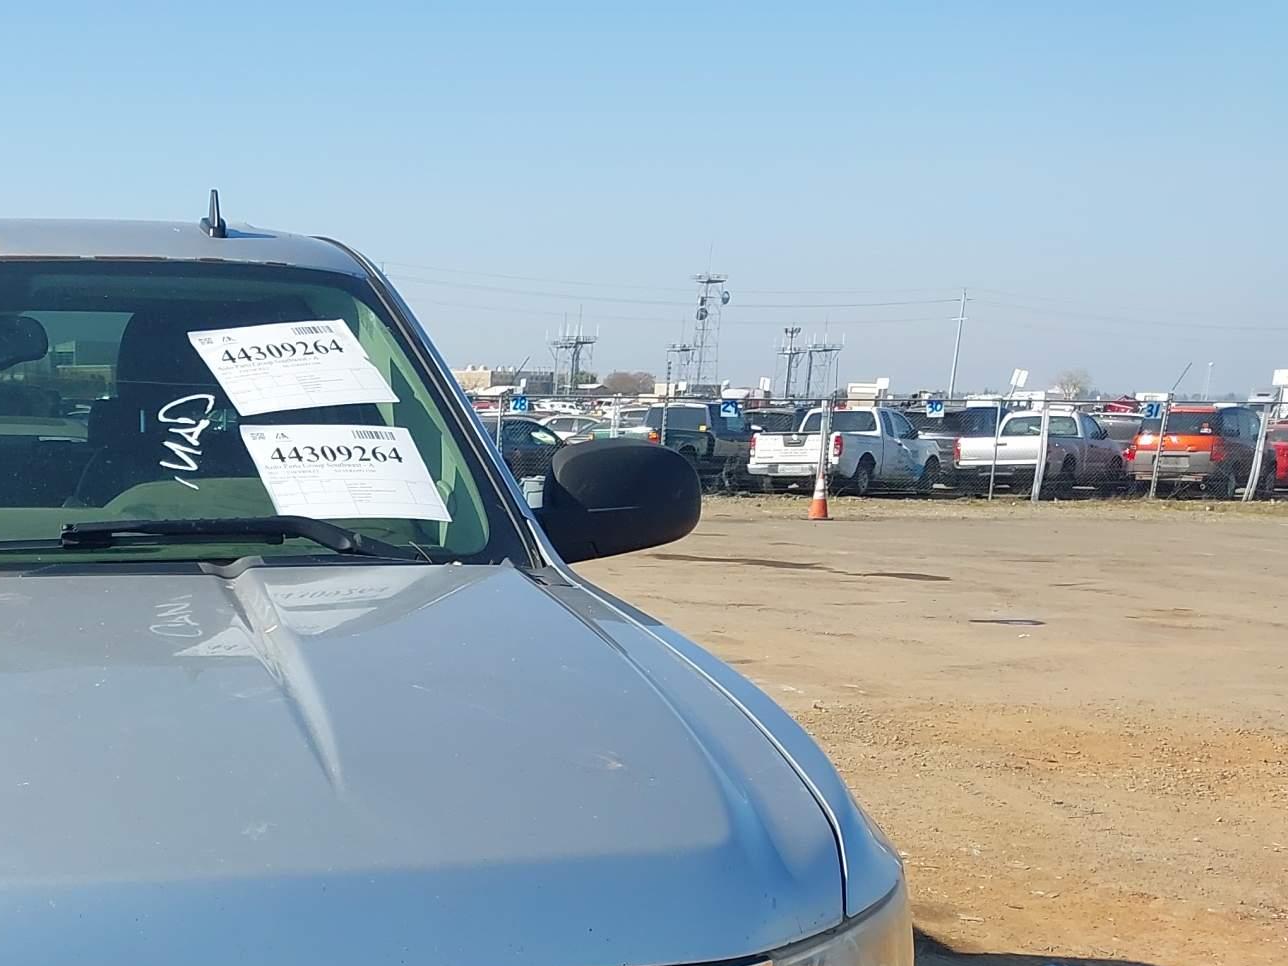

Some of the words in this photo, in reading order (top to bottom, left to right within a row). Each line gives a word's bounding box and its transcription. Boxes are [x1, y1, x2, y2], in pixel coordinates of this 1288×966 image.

[221, 339, 344, 363] 44309264
[511, 396, 527, 411] 28
[721, 400, 739, 415] 29
[927, 400, 943, 414] 30
[1145, 403, 1161, 418] 31
[270, 445, 403, 463] 44309264
